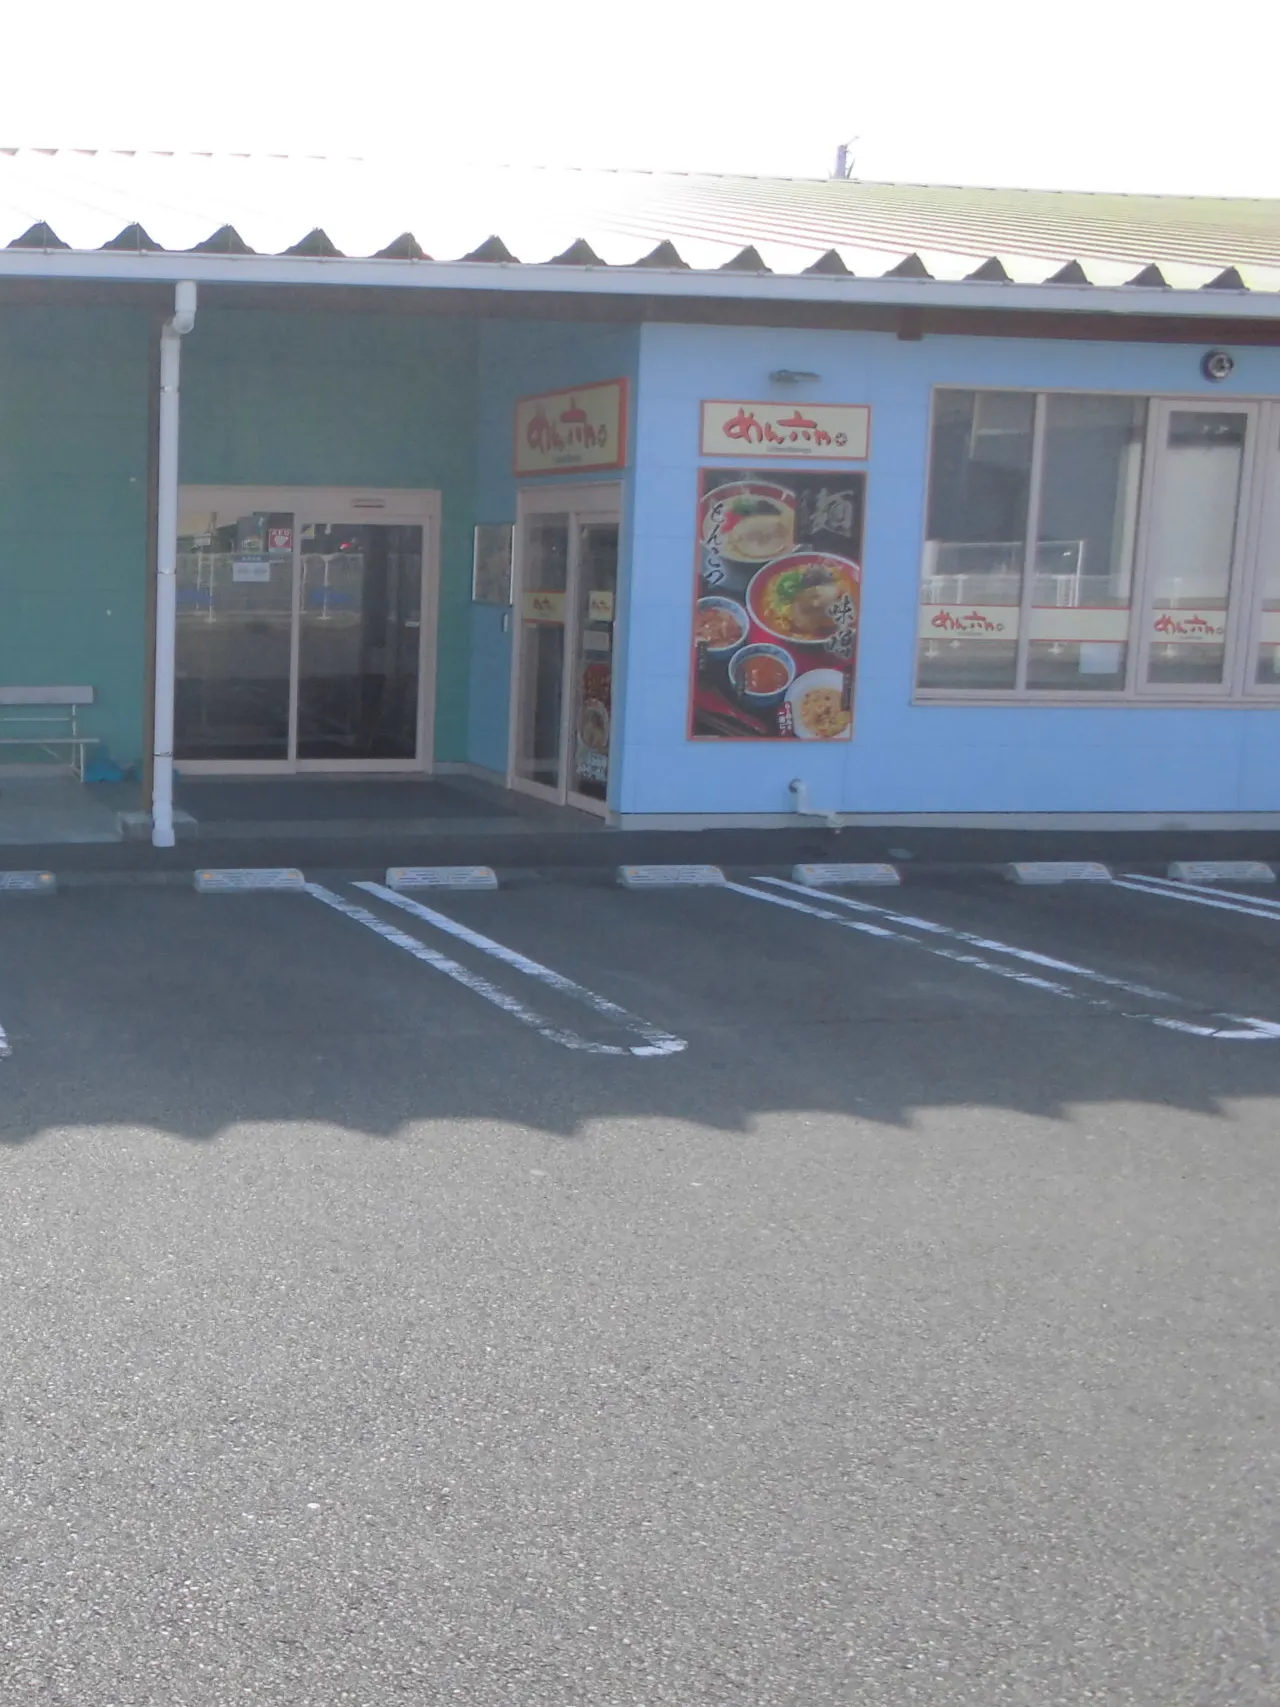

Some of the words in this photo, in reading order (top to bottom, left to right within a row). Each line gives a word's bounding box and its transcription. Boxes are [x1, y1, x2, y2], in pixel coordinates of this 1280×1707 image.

[722, 406, 832, 446] めん六や
[704, 501, 726, 587] とんこつ
